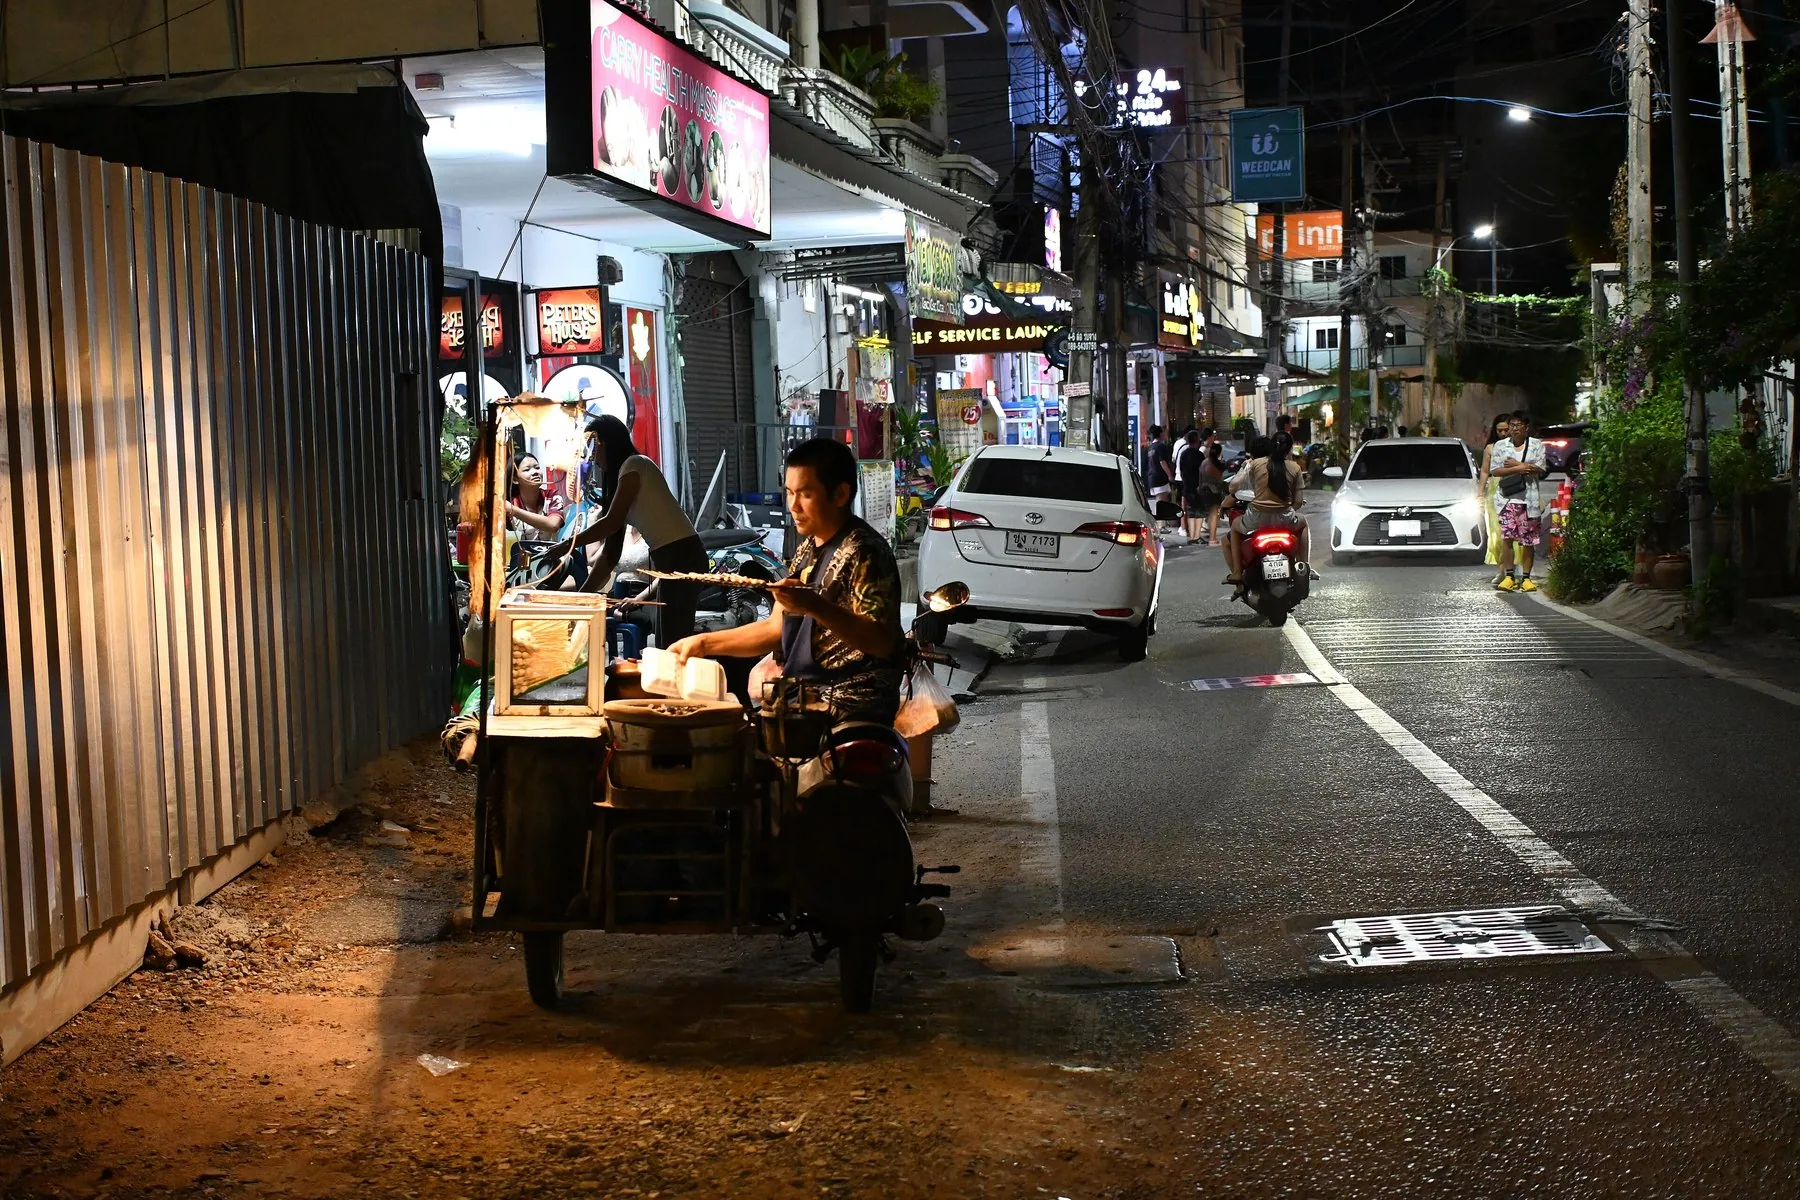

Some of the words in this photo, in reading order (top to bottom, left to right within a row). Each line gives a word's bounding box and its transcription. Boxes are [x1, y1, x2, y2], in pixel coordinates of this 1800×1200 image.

[600, 26, 643, 84] CARRY
[643, 50, 689, 110] HEALTH
[689, 76, 737, 131] MASSAGE
[1136, 68, 1167, 94] 24
[1241, 160, 1291, 172] WEEDCAN
[1297, 220, 1343, 246] inn
[541, 303, 599, 326] PETER'S
[547, 321, 592, 347] HOUSE
[911, 330, 932, 345] ELF
[939, 328, 1001, 343] SERVICE
[1005, 325, 1066, 341] LAUN
[1032, 535, 1055, 547] 7173
